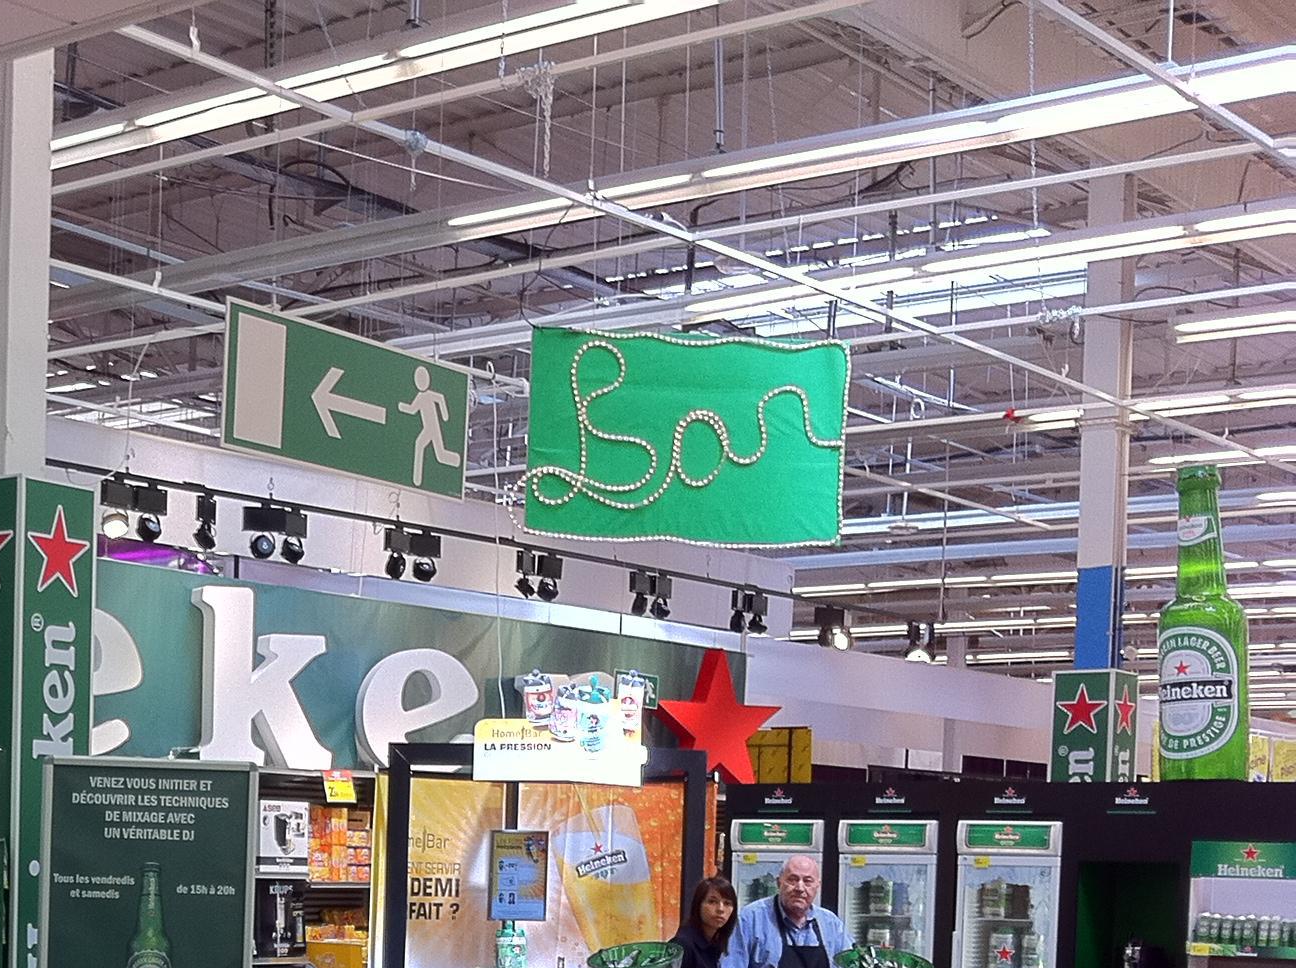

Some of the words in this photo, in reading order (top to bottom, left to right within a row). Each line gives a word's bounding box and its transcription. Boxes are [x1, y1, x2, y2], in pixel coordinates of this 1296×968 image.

[484, 743, 497, 751] LA
[500, 743, 552, 751] PRESSION
[89, 776, 125, 789] VENEZ
[126, 777, 157, 790] VOUS
[158, 778, 198, 792] INITIER
[200, 779, 213, 792] ET
[71, 790, 136, 806] DÉCOUVRIR
[138, 794, 158, 807] LES
[160, 795, 230, 810] TECHNIQUES
[105, 810, 121, 823] DE
[122, 811, 165, 824] MIXAGE
[167, 813, 196, 825] AVEC
[104, 827, 121, 839] UN
[122, 825, 180, 841] VÉRITABLE
[182, 829, 195, 841] DJ
[425, 861, 461, 876] SERVIR
[577, 853, 625, 876] Heineken
[1217, 863, 1284, 878] Heineken
[53, 873, 74, 884] Tous
[76, 873, 90, 885] les
[91, 874, 135, 886] vendredis
[70, 888, 81, 899] et
[82, 888, 120, 900] samedis
[176, 884, 189, 895] de
[190, 885, 208, 896] 15h
[209, 884, 216, 895] à
[269, 884, 294, 895] KRUPS
[410, 877, 461, 898] DEMI
[409, 901, 444, 921] FAIT
[449, 902, 460, 920] ?
